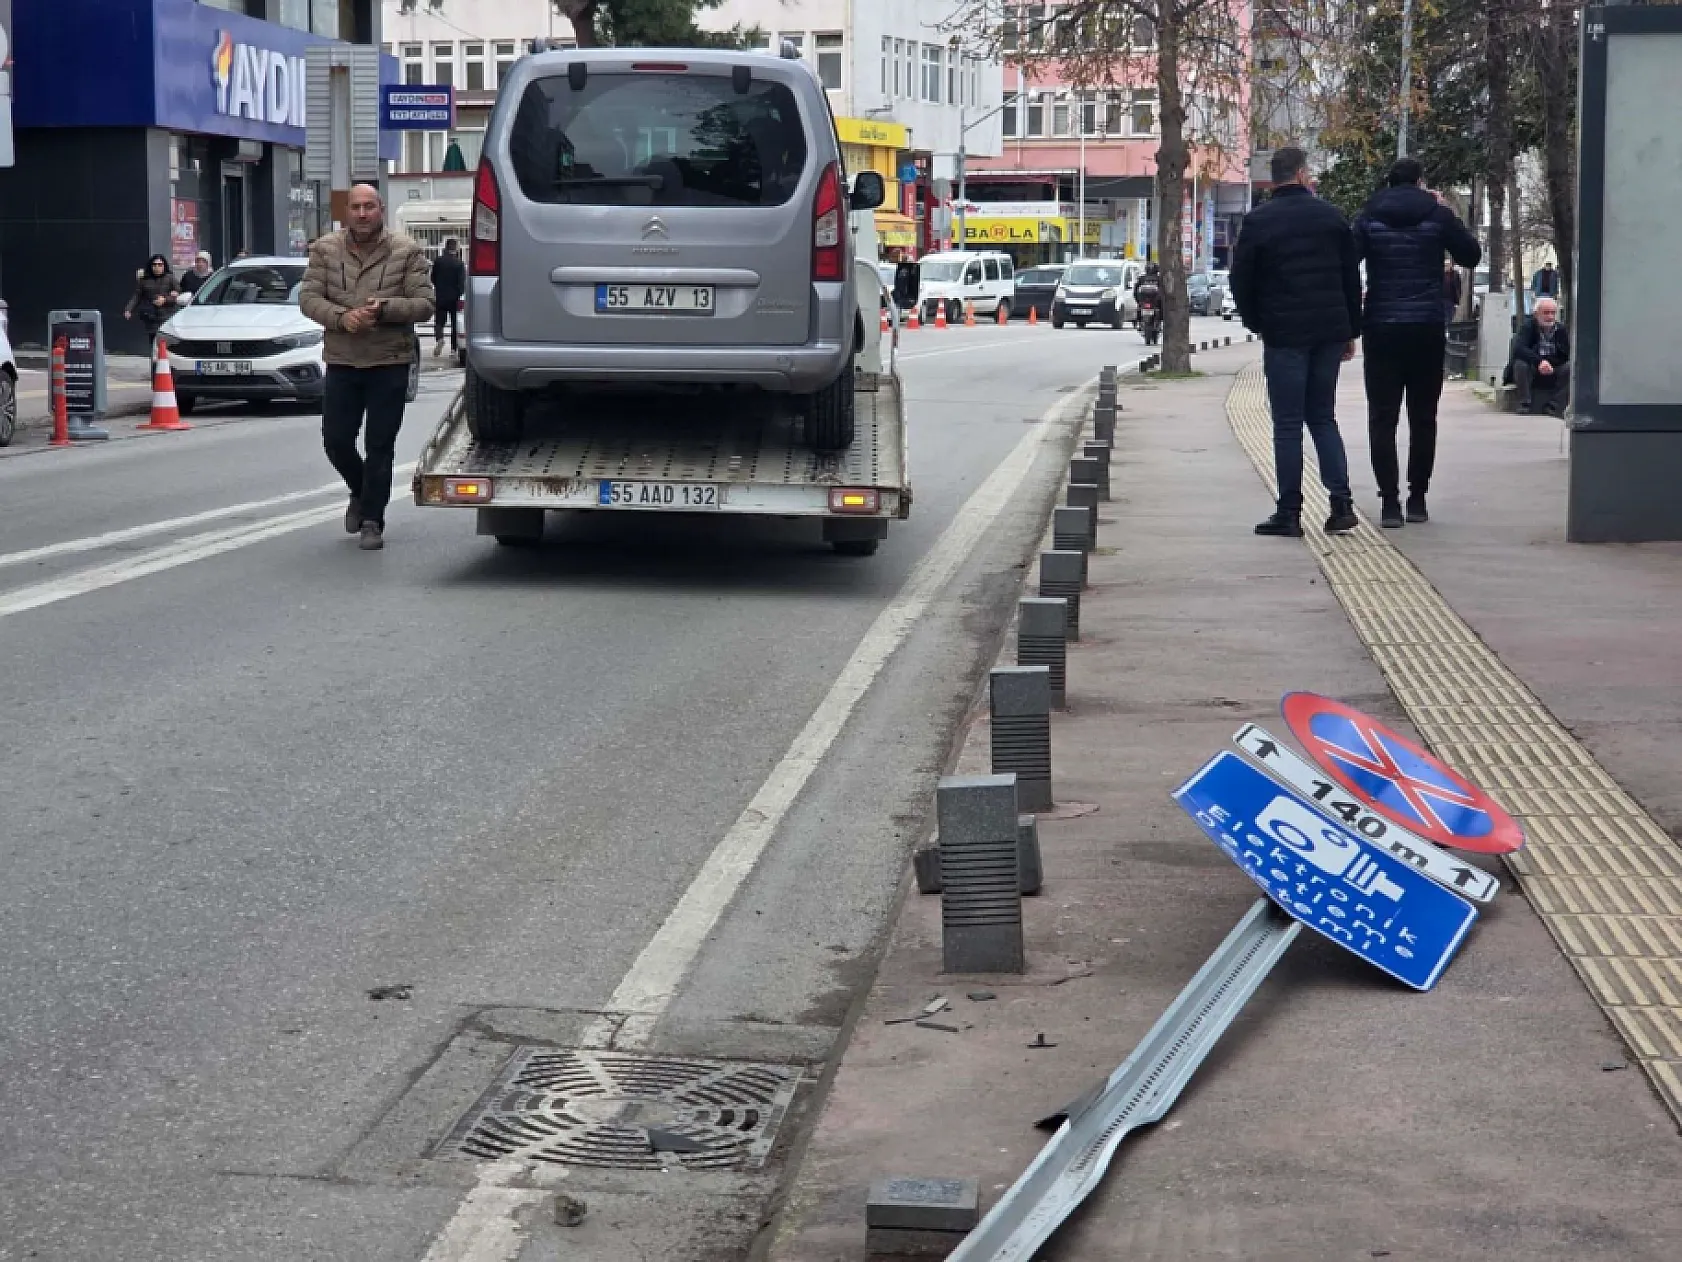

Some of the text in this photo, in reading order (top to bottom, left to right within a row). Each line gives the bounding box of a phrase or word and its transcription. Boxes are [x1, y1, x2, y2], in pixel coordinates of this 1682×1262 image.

[608, 287, 709, 308] 55 AZV 13
[611, 484, 715, 505] 55 AAD 132
[1311, 780, 1428, 868] 140 m
[1195, 810, 1414, 959] Denetleme
[1207, 804, 1418, 945] Elektronik
